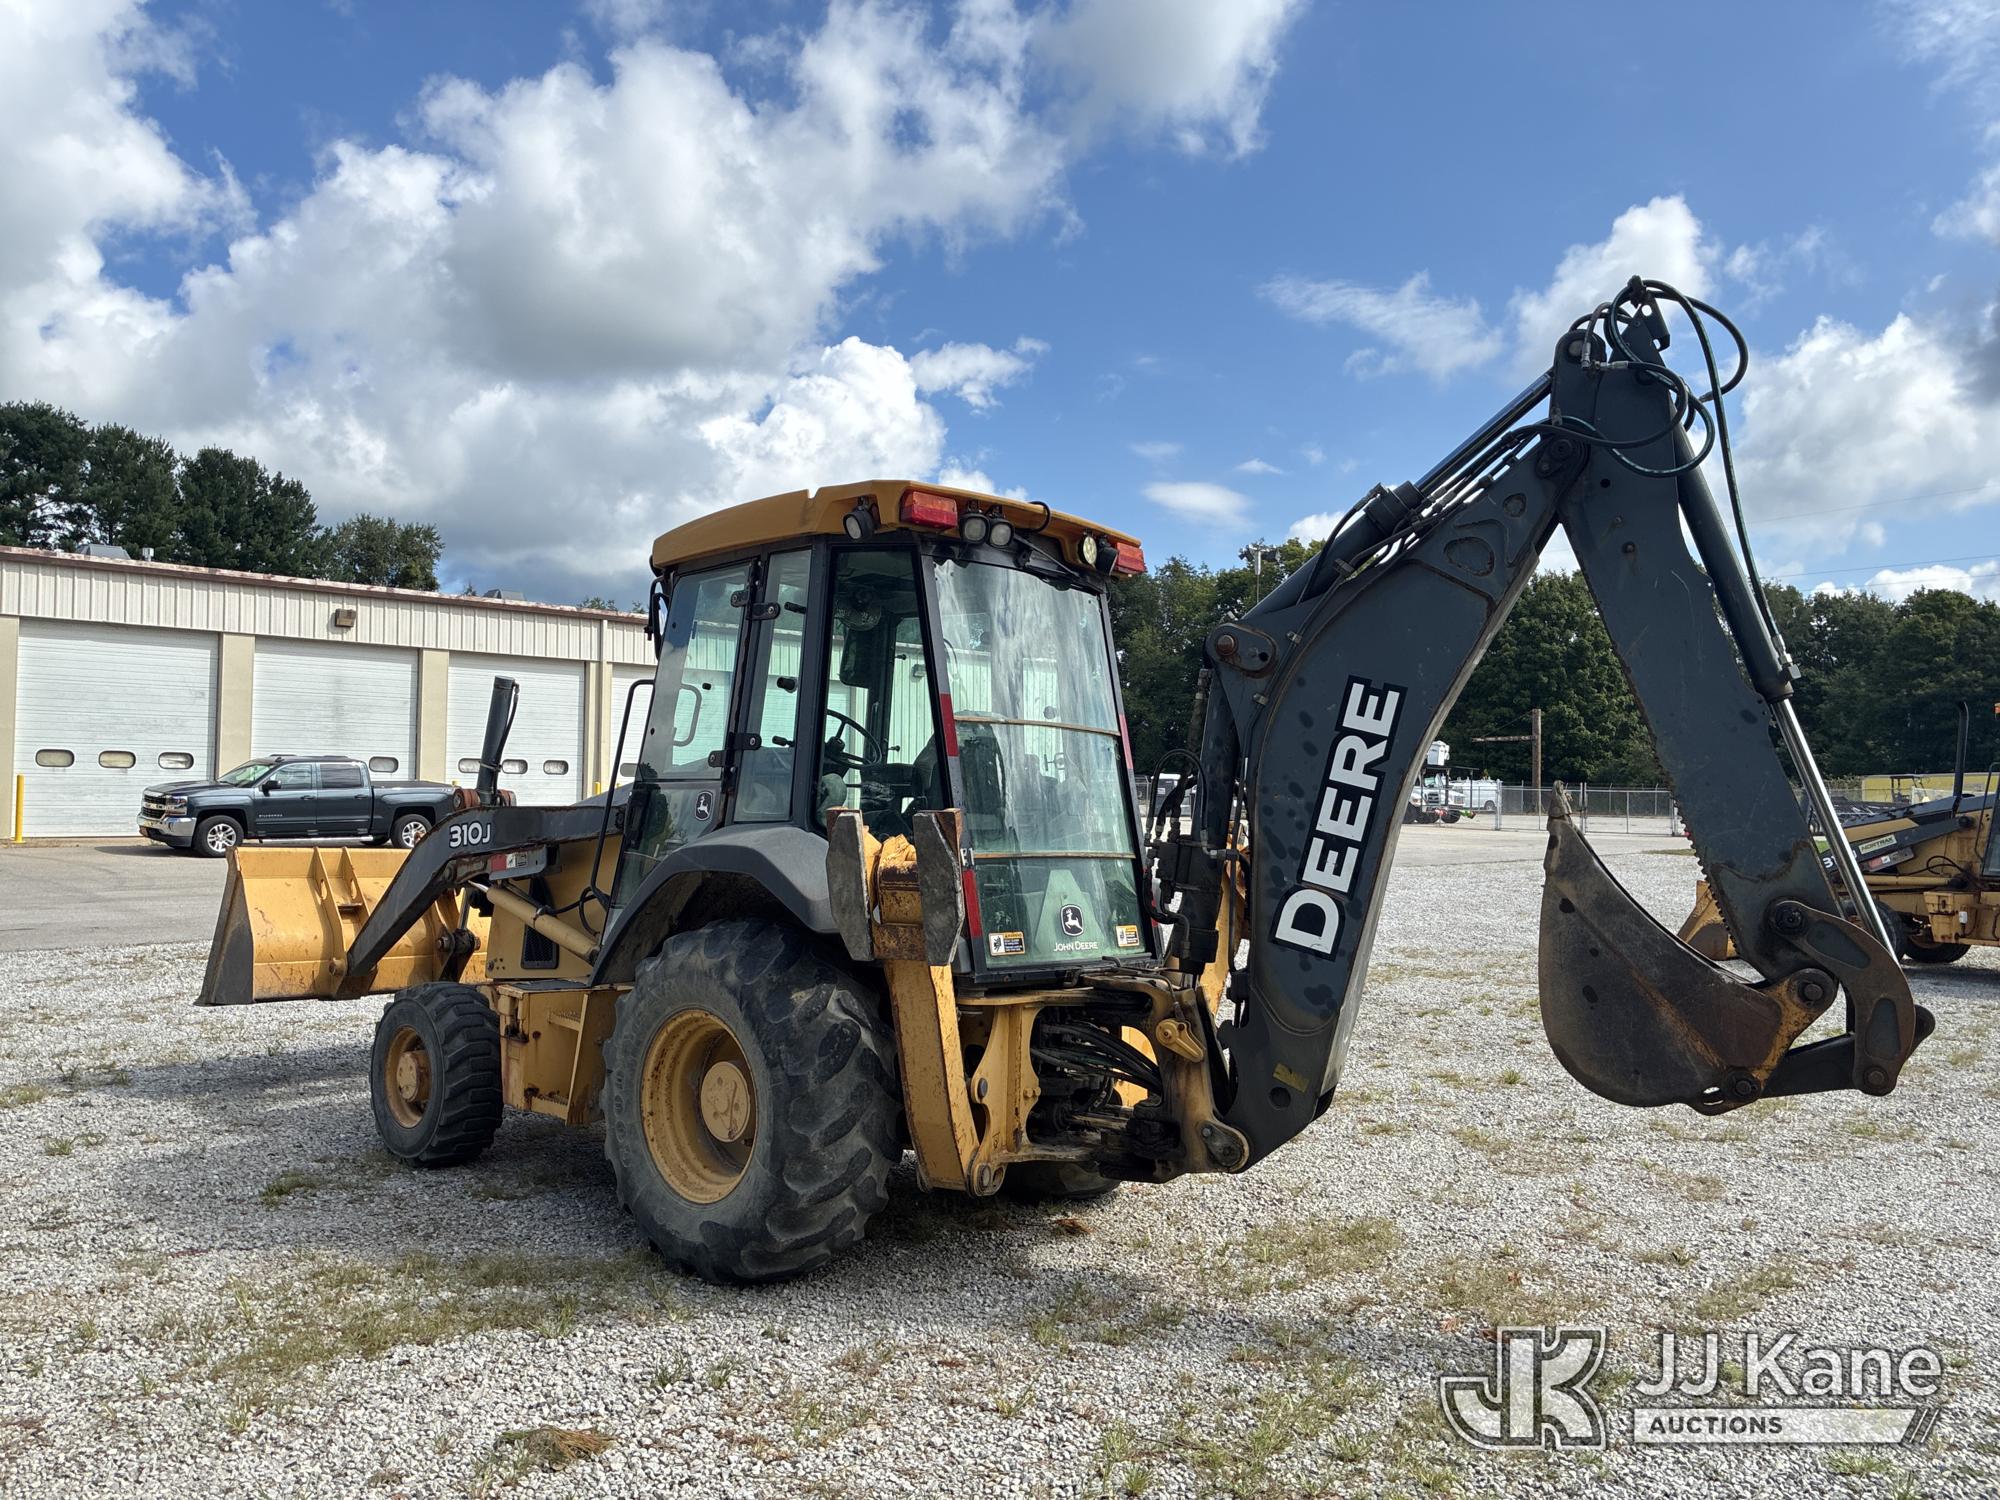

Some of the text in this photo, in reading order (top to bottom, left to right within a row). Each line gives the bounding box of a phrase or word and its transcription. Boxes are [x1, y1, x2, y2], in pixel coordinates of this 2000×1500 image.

[1275, 682, 1400, 954] DEERE
[449, 822, 491, 848] 310J
[1053, 941, 1099, 952] JOHN DEERE
